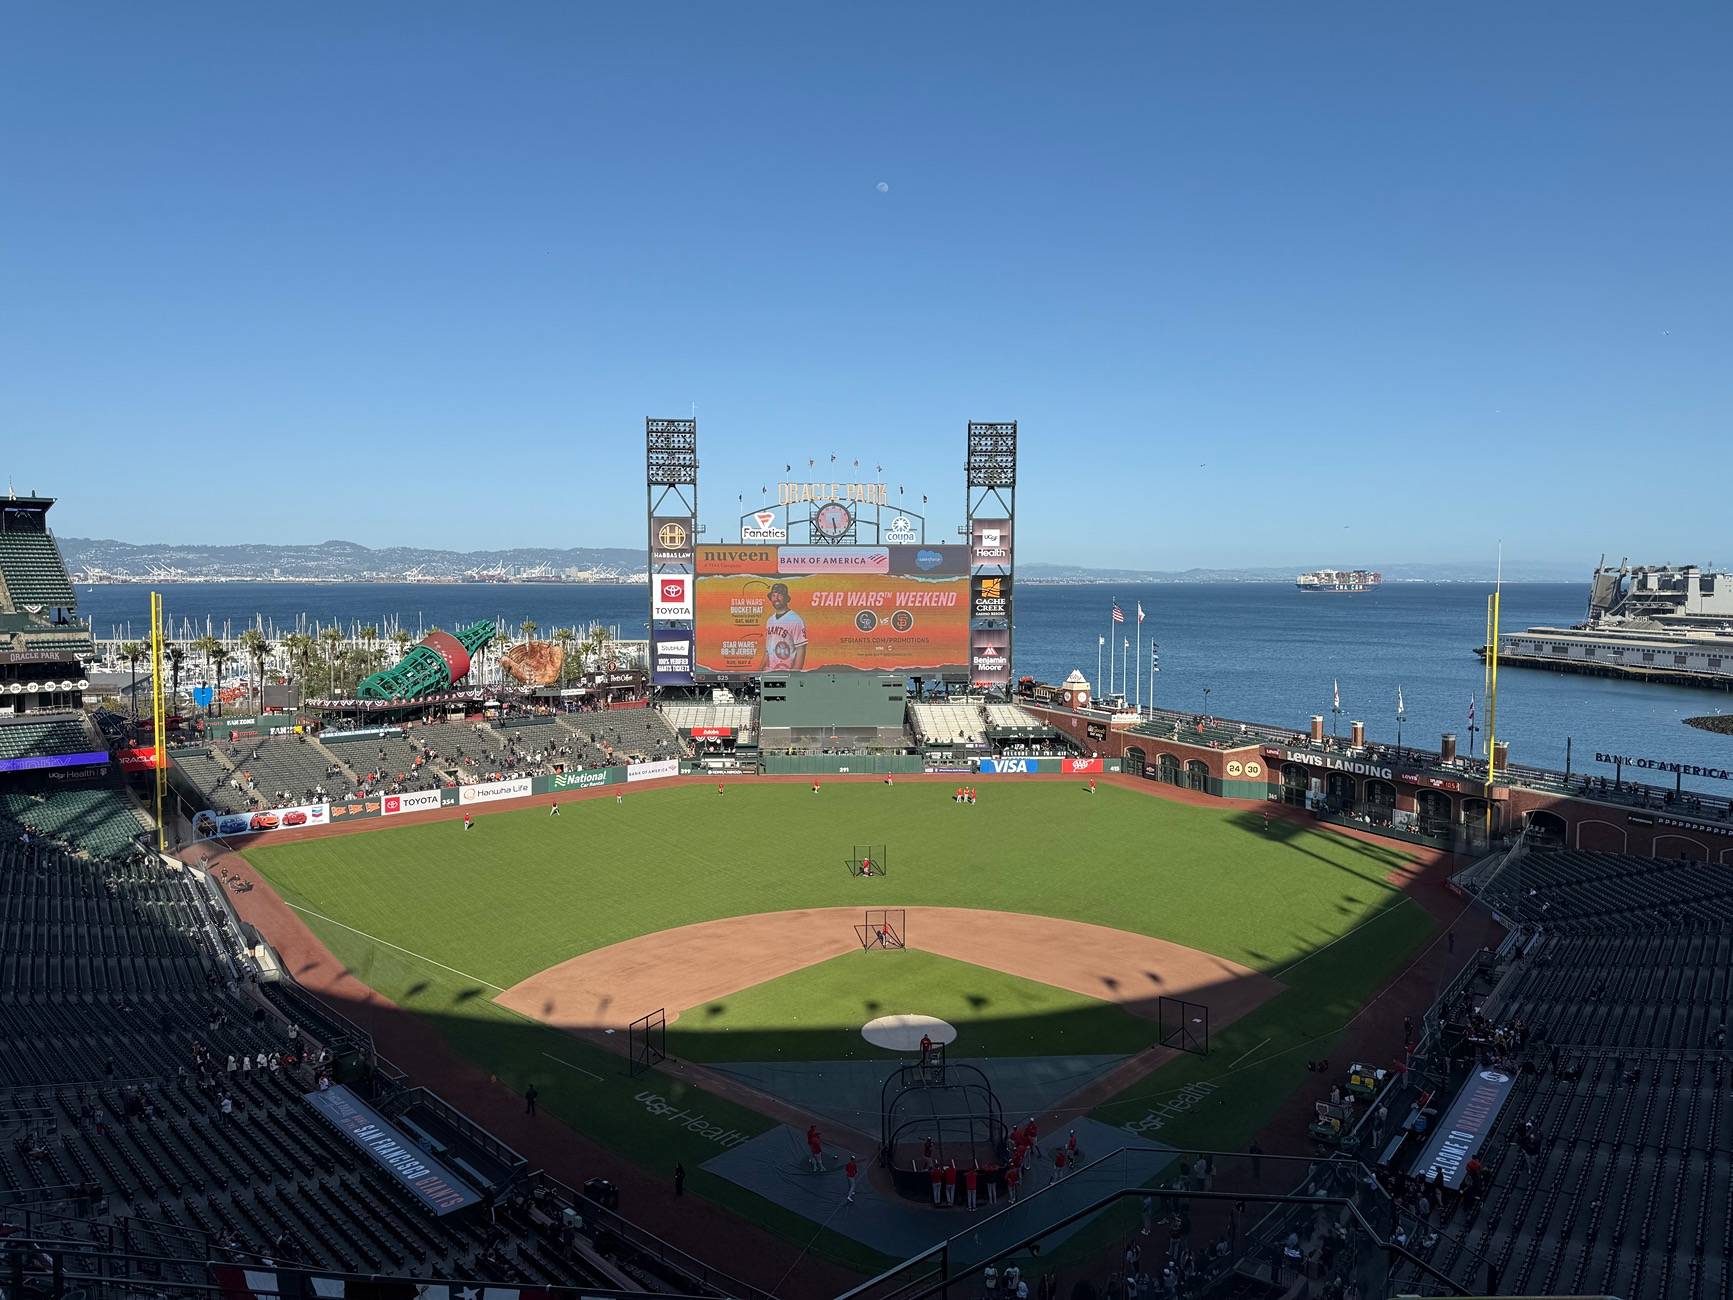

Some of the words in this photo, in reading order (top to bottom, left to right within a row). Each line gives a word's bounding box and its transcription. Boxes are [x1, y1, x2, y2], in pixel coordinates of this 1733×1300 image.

[778, 482, 839, 505] ORACLE
[848, 483, 887, 505] PARK
[744, 527, 785, 538] Fanatics
[888, 533, 914, 543] coupa
[705, 551, 770, 562] nuveen
[977, 548, 1006, 556] Health
[780, 557, 807, 565] BANK
[808, 557, 821, 565] OF
[823, 557, 866, 565] AMERICA
[731, 598, 745, 606] STAR
[811, 592, 843, 607] STAR
[896, 592, 957, 607] WEEKEND
[655, 607, 691, 615] TOYOTA
[730, 606, 752, 614] BUCKET
[976, 604, 1005, 612] CREEK
[10, 652, 39, 661] ORACLE
[41, 651, 60, 660] PARK
[736, 648, 757, 656] JERSEY
[973, 656, 1007, 664] Benjamin
[993, 759, 1028, 773] VISA
[1073, 759, 1088, 769] AAA
[1229, 764, 1240, 772] 24
[1326, 758, 1393, 780] LANDING
[1595, 752, 1632, 766] BANK
[1637, 758, 1658, 769] OF
[1658, 761, 1728, 780] AMERICA
[66, 769, 95, 779] Health
[567, 770, 607, 785] National
[477, 786, 512, 798] Hanwha
[514, 783, 528, 794] Life
[403, 796, 438, 807] TOYOTA
[1147, 1081, 1221, 1119] Health
[353, 1124, 386, 1142] SAN
[369, 1137, 430, 1180] FRANCISCO
[1425, 1140, 1469, 1182] WELCOME
[1448, 1129, 1475, 1143] TO
[415, 1176, 464, 1207] GIANTS
